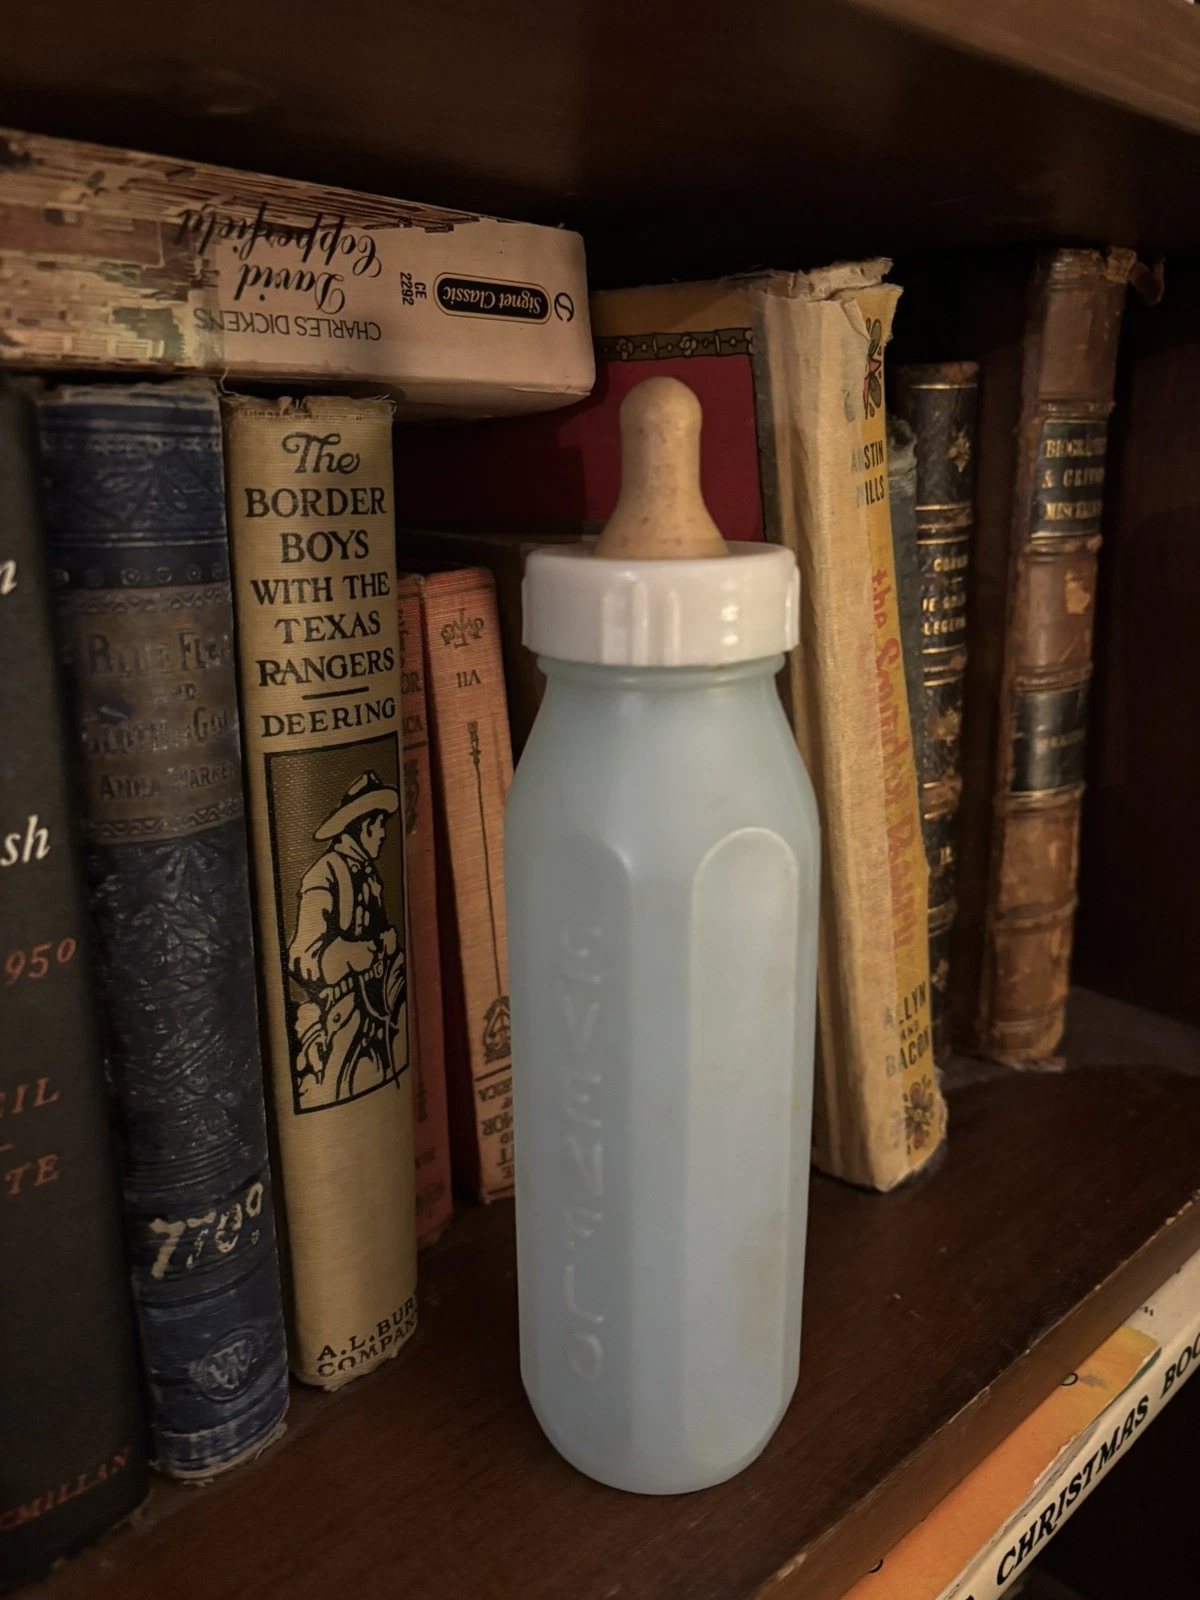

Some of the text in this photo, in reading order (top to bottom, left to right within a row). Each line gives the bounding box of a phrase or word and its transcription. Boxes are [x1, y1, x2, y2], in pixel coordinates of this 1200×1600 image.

[176, 202, 382, 278] Copperfield
[233, 264, 346, 315] David
[400, 272, 413, 306] 2292
[414, 282, 427, 300] CE
[442, 285, 543, 315] Signet Classic
[193, 308, 382, 341] CHARLES DICKENS
[282, 433, 361, 474] The
[245, 487, 387, 518] BORDER
[280, 530, 370, 564] BOYS
[250, 571, 391, 606] WITH THE
[275, 610, 382, 644] TEXAS
[256, 648, 395, 686] RANGERS
[261, 697, 397, 738] DEERING
[996, 1395, 1150, 1586] CHRISTMAS
